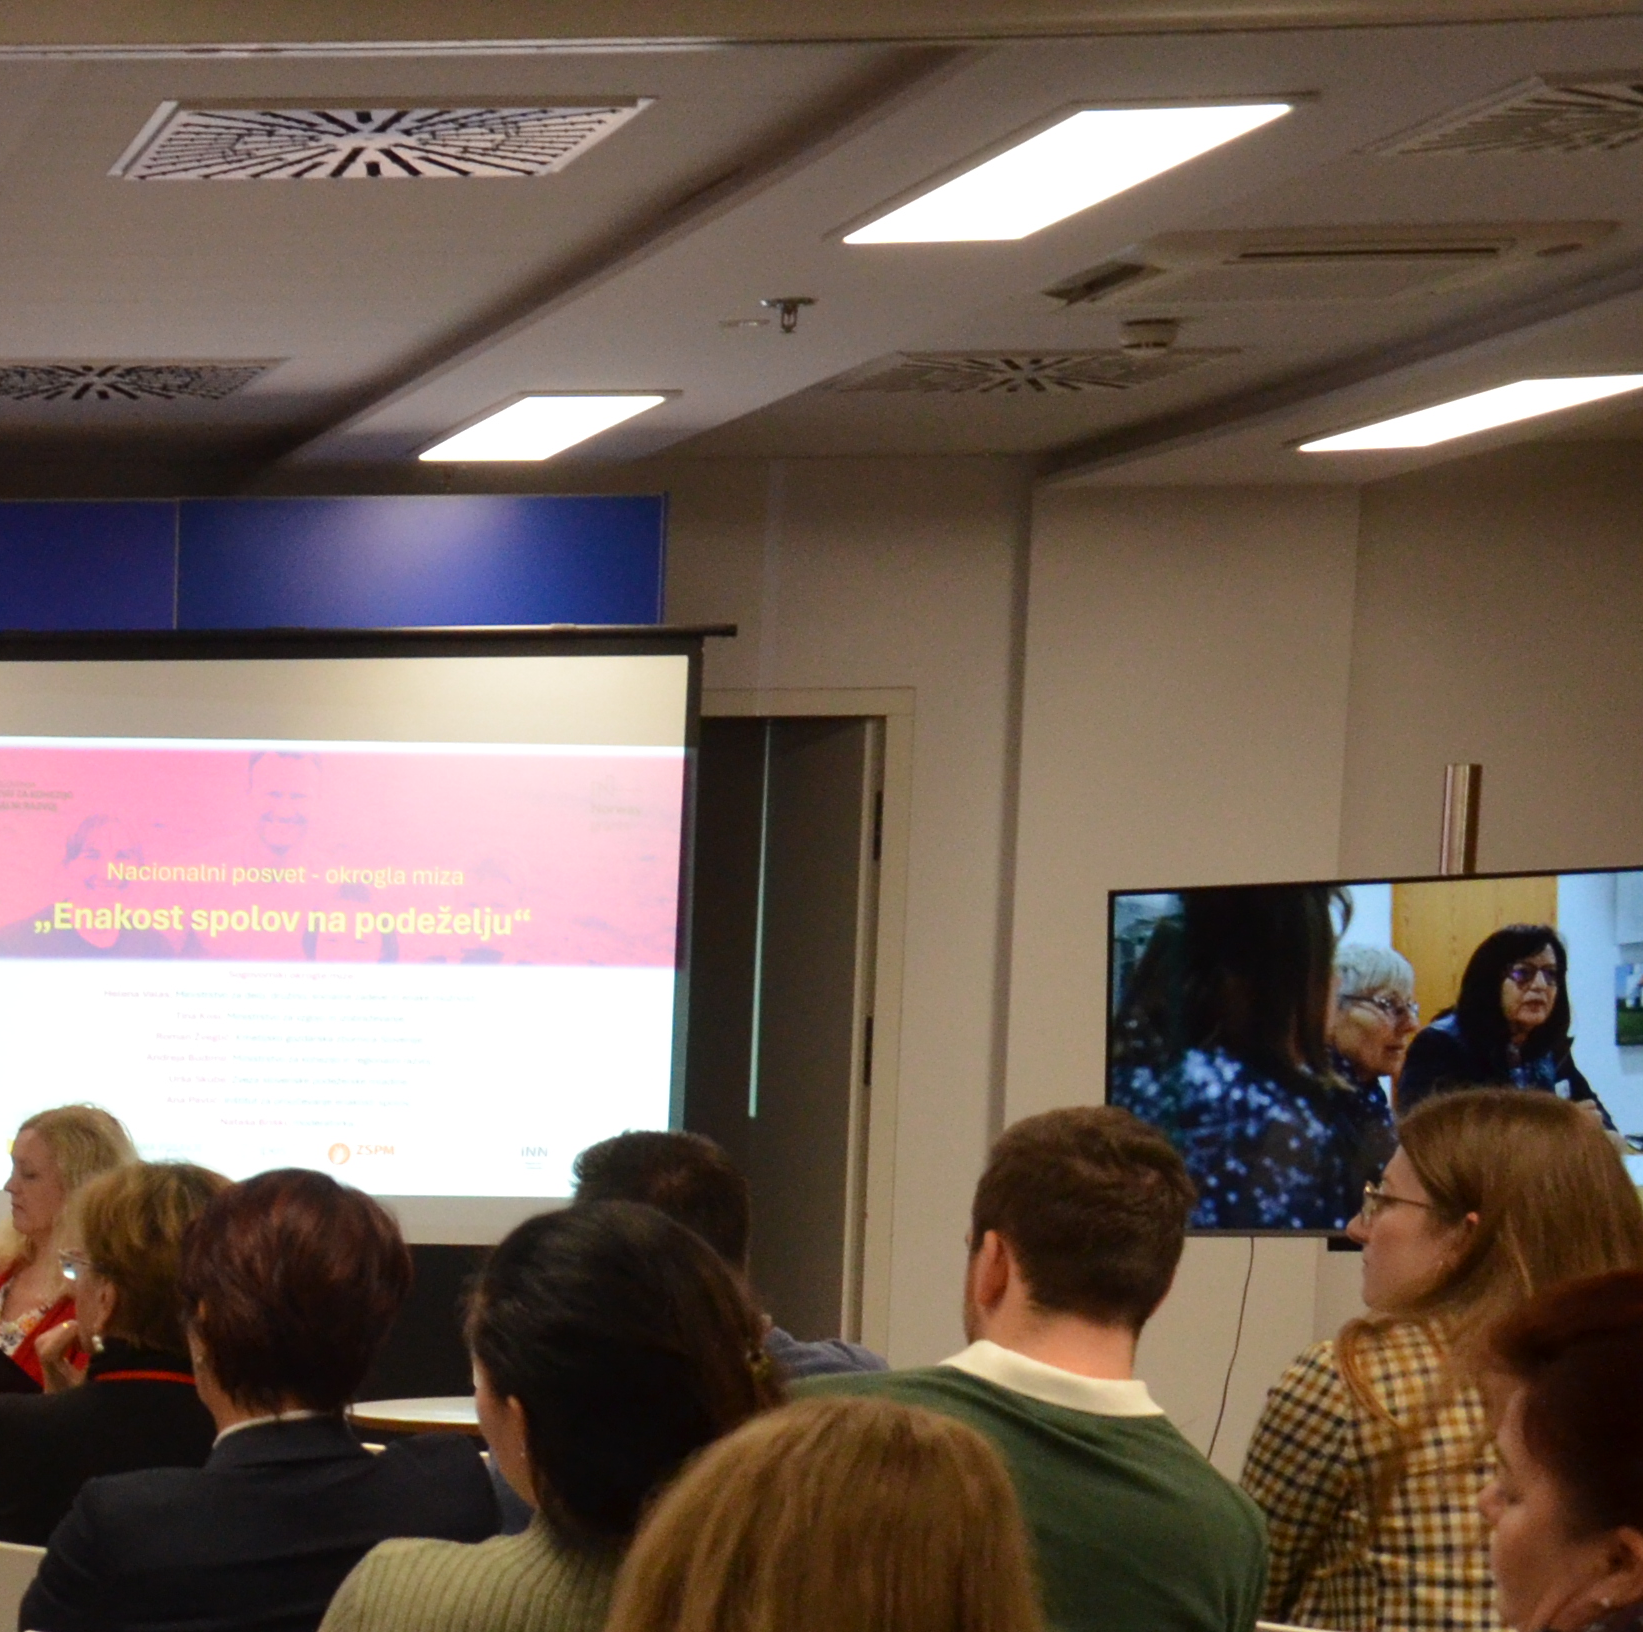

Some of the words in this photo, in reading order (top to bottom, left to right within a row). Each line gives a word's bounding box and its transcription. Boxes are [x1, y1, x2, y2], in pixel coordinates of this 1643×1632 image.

[107, 860, 227, 883] Nacionalni
[231, 864, 307, 886] posvet
[325, 863, 406, 889] okrogla
[412, 866, 465, 886] miza
[190, 905, 299, 937] spolov
[307, 911, 347, 933] na
[356, 1144, 396, 1156] ZSPM
